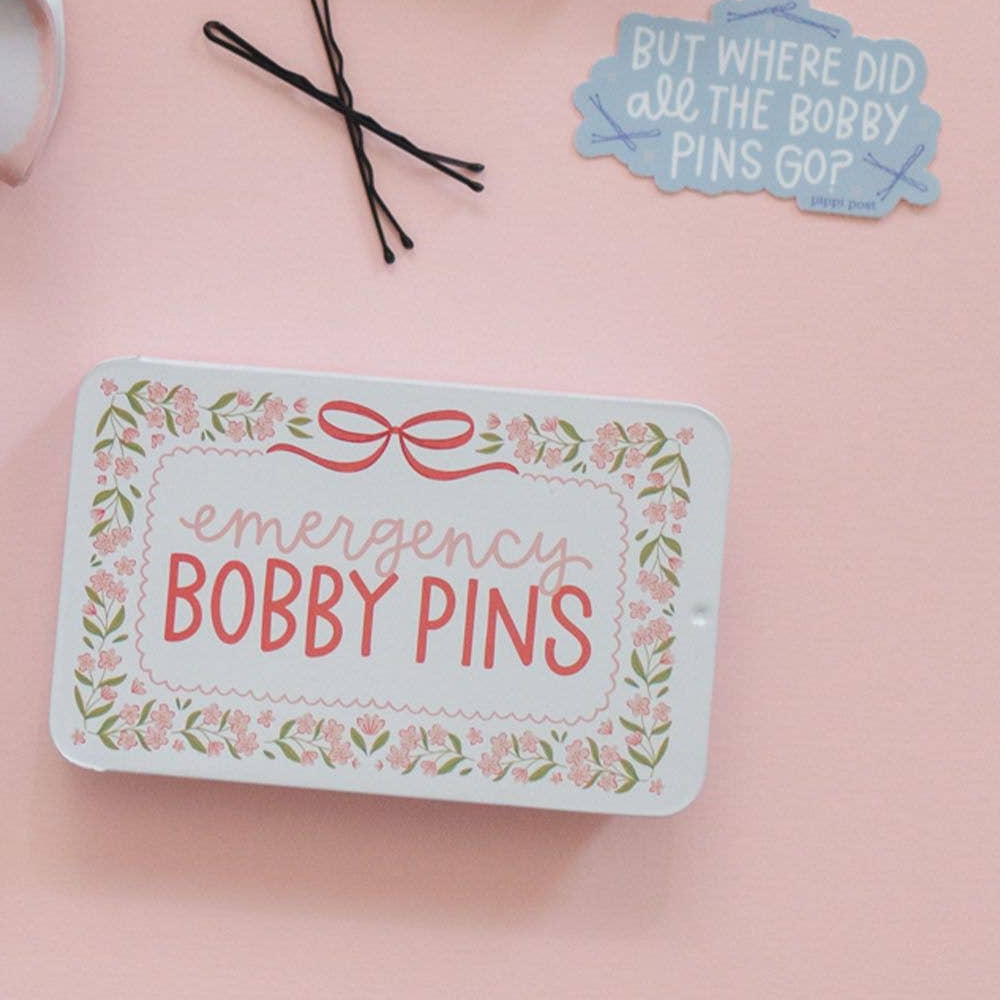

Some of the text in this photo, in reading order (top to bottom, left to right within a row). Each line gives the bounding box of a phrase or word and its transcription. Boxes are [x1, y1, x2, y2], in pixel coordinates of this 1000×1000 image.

[631, 25, 916, 95] BUT WHERE DID
[626, 73, 909, 146] all THE BOBBY
[669, 131, 854, 192] PINS GO?
[809, 195, 877, 212] pippi post
[178, 504, 594, 597] emergency
[163, 552, 593, 677] BOBBY PINS
